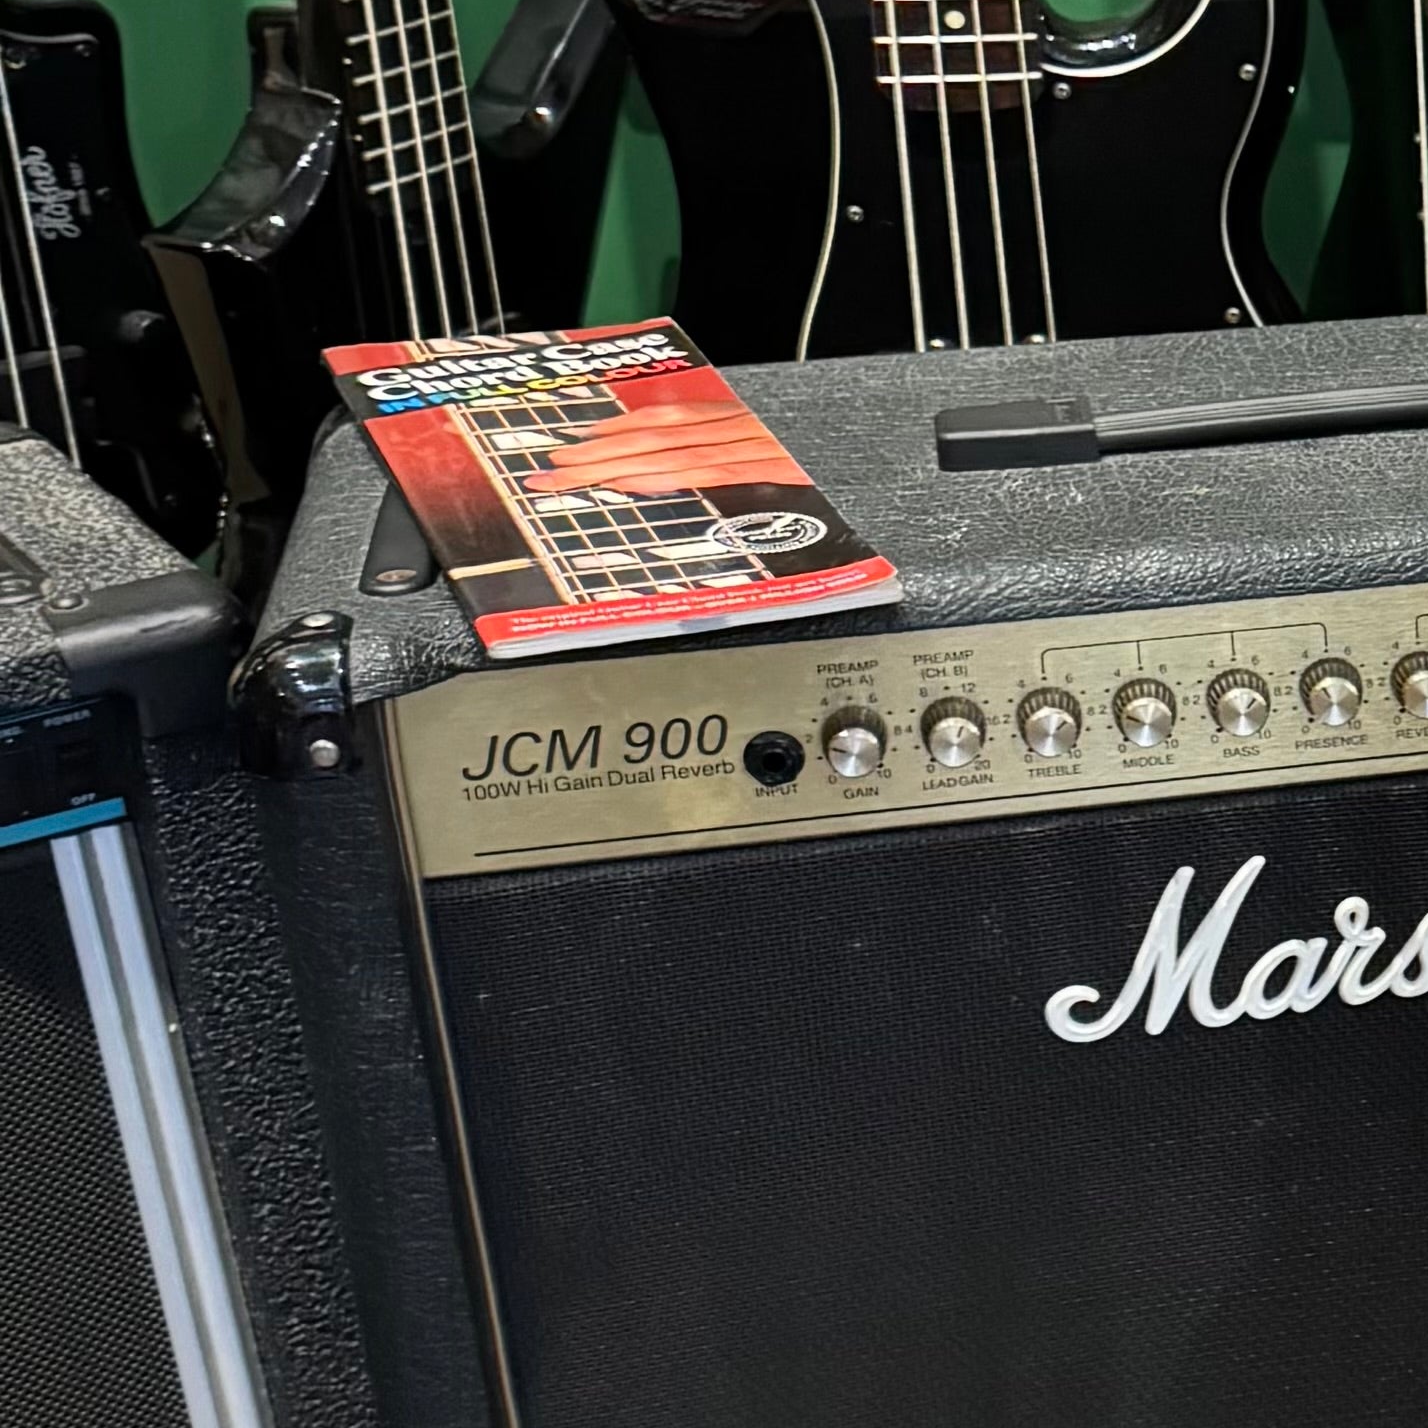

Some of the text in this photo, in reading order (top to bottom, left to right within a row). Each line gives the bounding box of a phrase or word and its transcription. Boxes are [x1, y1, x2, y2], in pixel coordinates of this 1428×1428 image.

[356, 333, 671, 388] Guitar Case
[367, 344, 690, 401] Chord Book
[377, 358, 694, 414] IN FULL COLOUR
[913, 650, 974, 665] PREAMP
[816, 660, 879, 675] PREAMP
[461, 713, 728, 782] JCM 900
[1295, 734, 1369, 750] PRESENCE
[1223, 746, 1261, 758] BASS
[1123, 754, 1175, 769] MIDDLE
[1028, 764, 1083, 778] TREBLE
[462, 759, 736, 802] 100W Hi Gain Dual Reverb
[843, 786, 880, 800] GAIN
